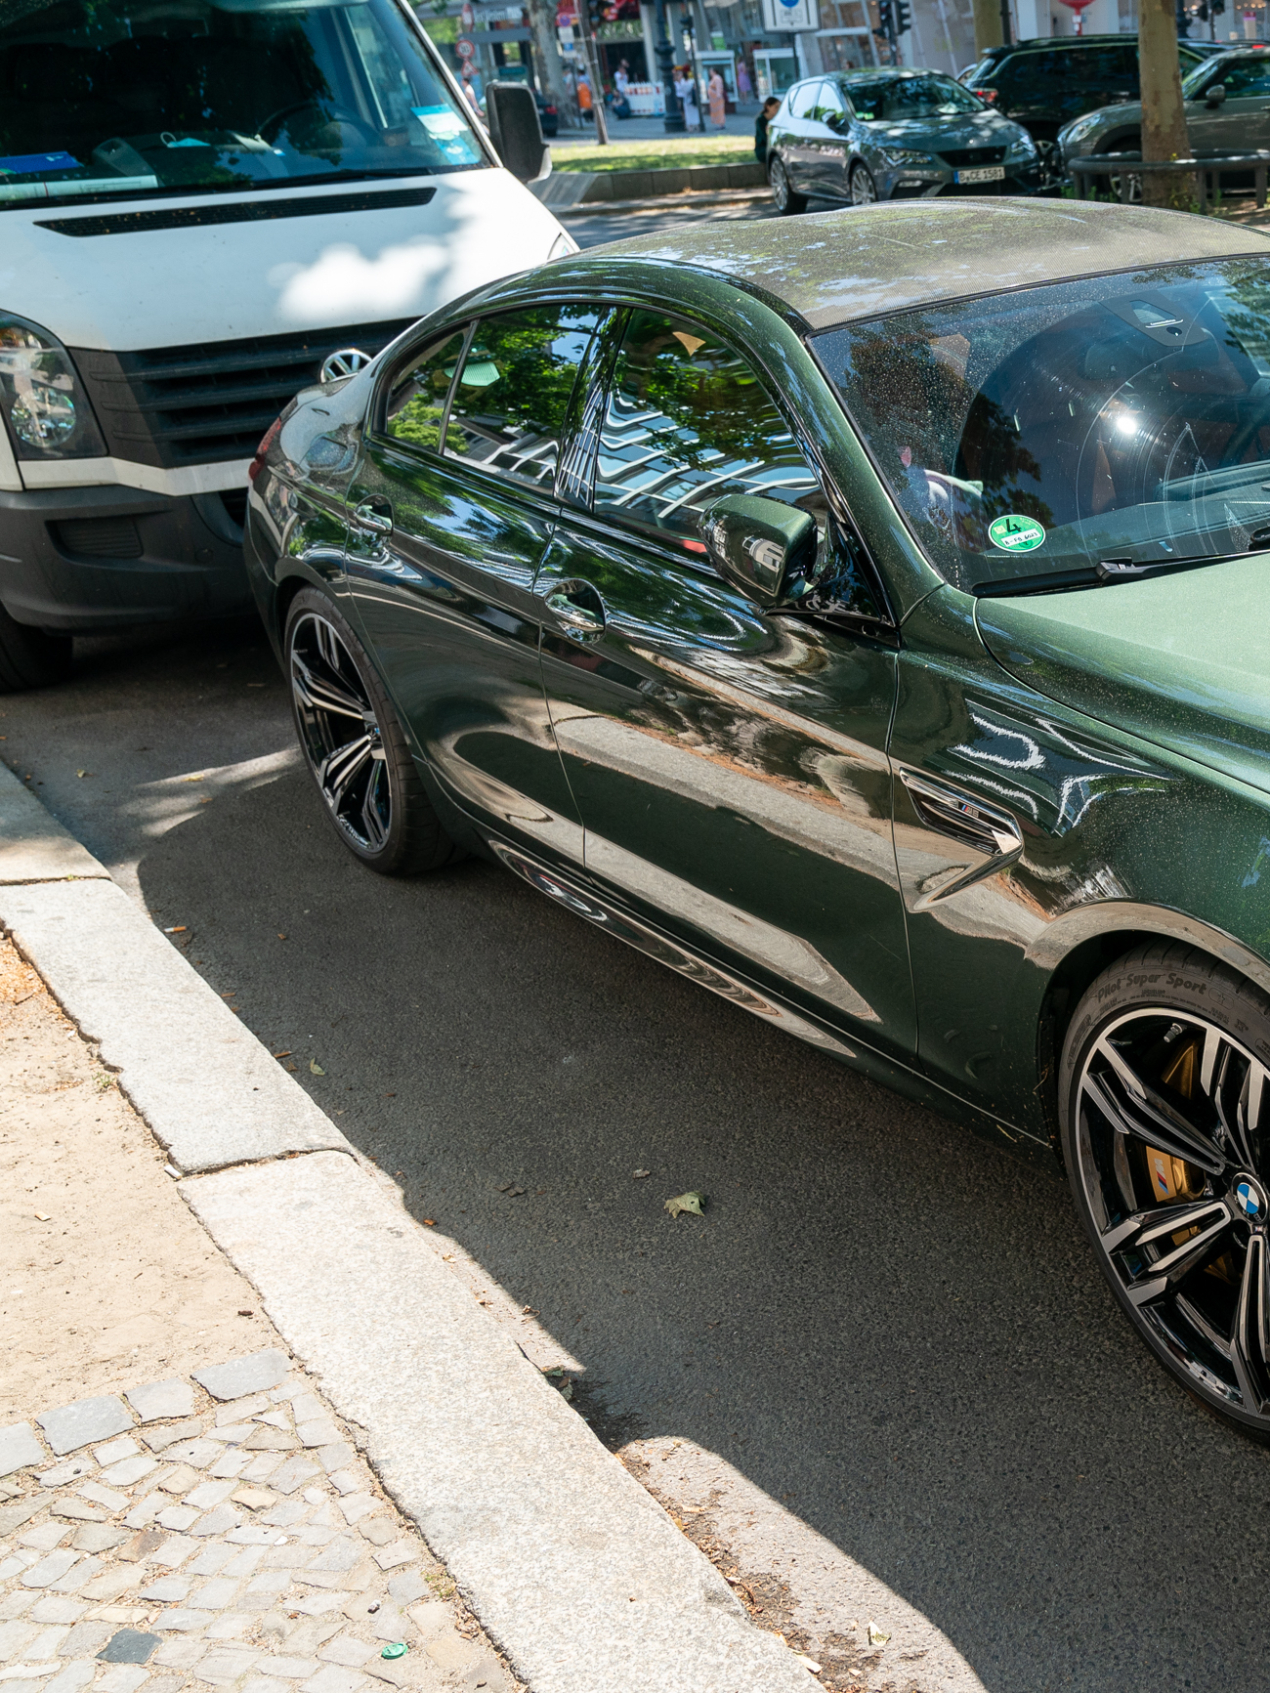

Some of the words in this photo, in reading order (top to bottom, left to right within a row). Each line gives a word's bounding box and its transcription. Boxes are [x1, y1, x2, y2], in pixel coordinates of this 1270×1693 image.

[1005, 518, 1021, 532] 4
[1098, 979, 1122, 1003] Pilot
[1126, 972, 1161, 988] Super
[1166, 972, 1208, 995] Sport
